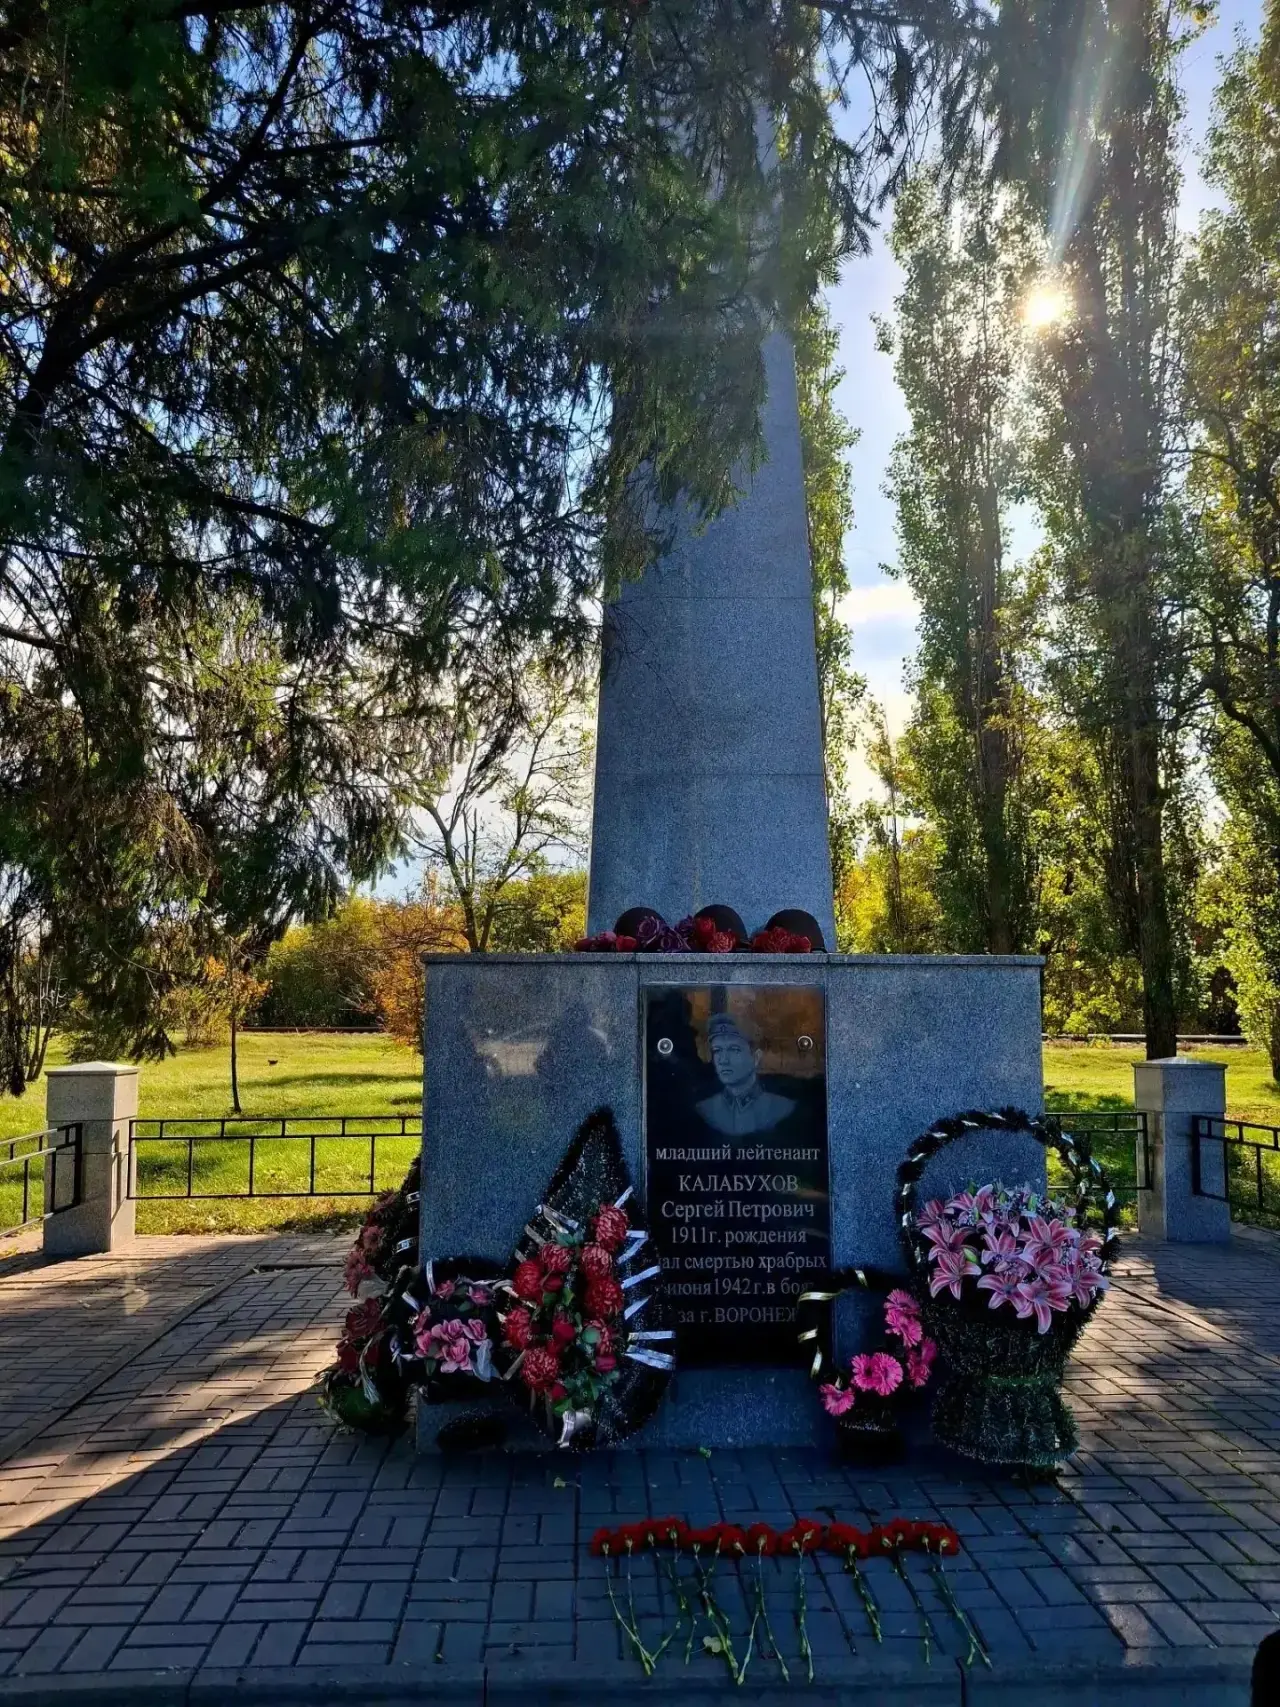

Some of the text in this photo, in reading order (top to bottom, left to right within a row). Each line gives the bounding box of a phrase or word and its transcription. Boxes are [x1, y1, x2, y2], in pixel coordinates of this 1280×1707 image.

[656, 1144, 820, 1162] младший лейтенант
[678, 1175, 799, 1192] КАЛАБУХОВ
[661, 1200, 815, 1222] Сергей Петрович
[725, 1229, 807, 1248] рождения
[684, 1256, 754, 1273] смертью
[758, 1251, 827, 1273] храбрых
[678, 1310, 695, 1324] за
